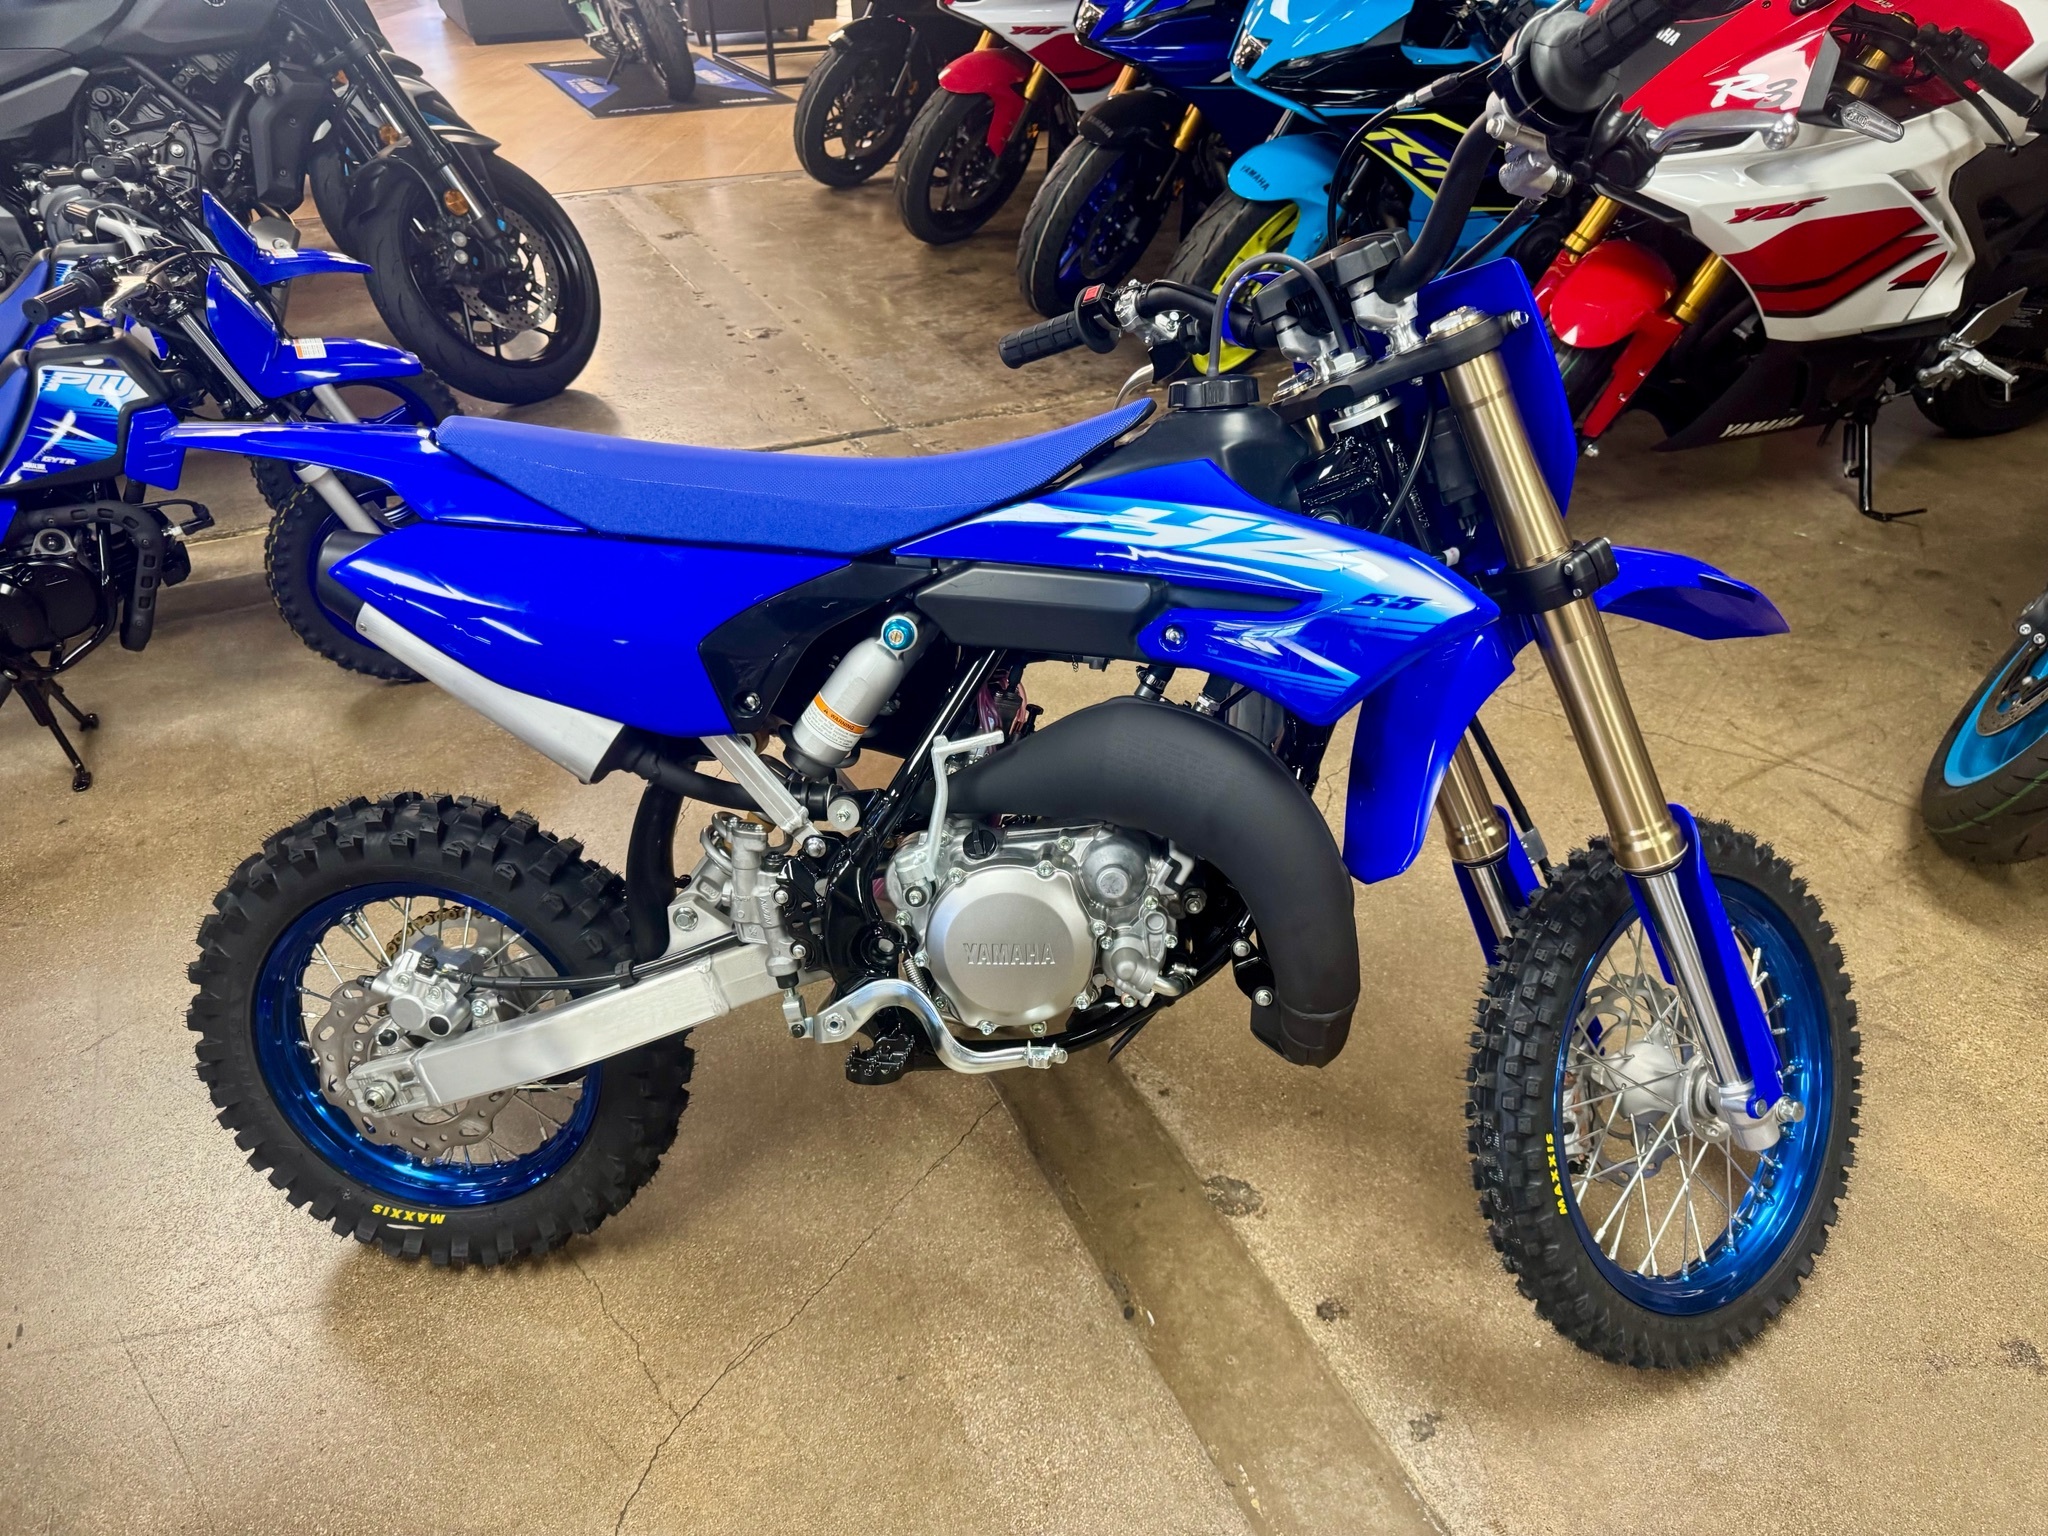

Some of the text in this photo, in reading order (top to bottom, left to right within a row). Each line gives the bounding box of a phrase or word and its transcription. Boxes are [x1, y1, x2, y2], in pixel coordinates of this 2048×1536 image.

[1708, 72, 1798, 109] R3
[1088, 115, 1115, 139] YAMAHA
[1240, 165, 1271, 191] YAMAHA
[1723, 195, 1830, 225] YZF
[44, 370, 136, 399] PW
[1719, 414, 1804, 438] YAMAHA
[41, 456, 78, 466] GYTR
[1351, 592, 1433, 611] 65
[830, 713, 855, 731] WARNING
[962, 942, 1056, 966] YAMAHA
[1545, 1133, 1568, 1215] MAXXIS
[371, 1204, 446, 1225] MAXXIS
